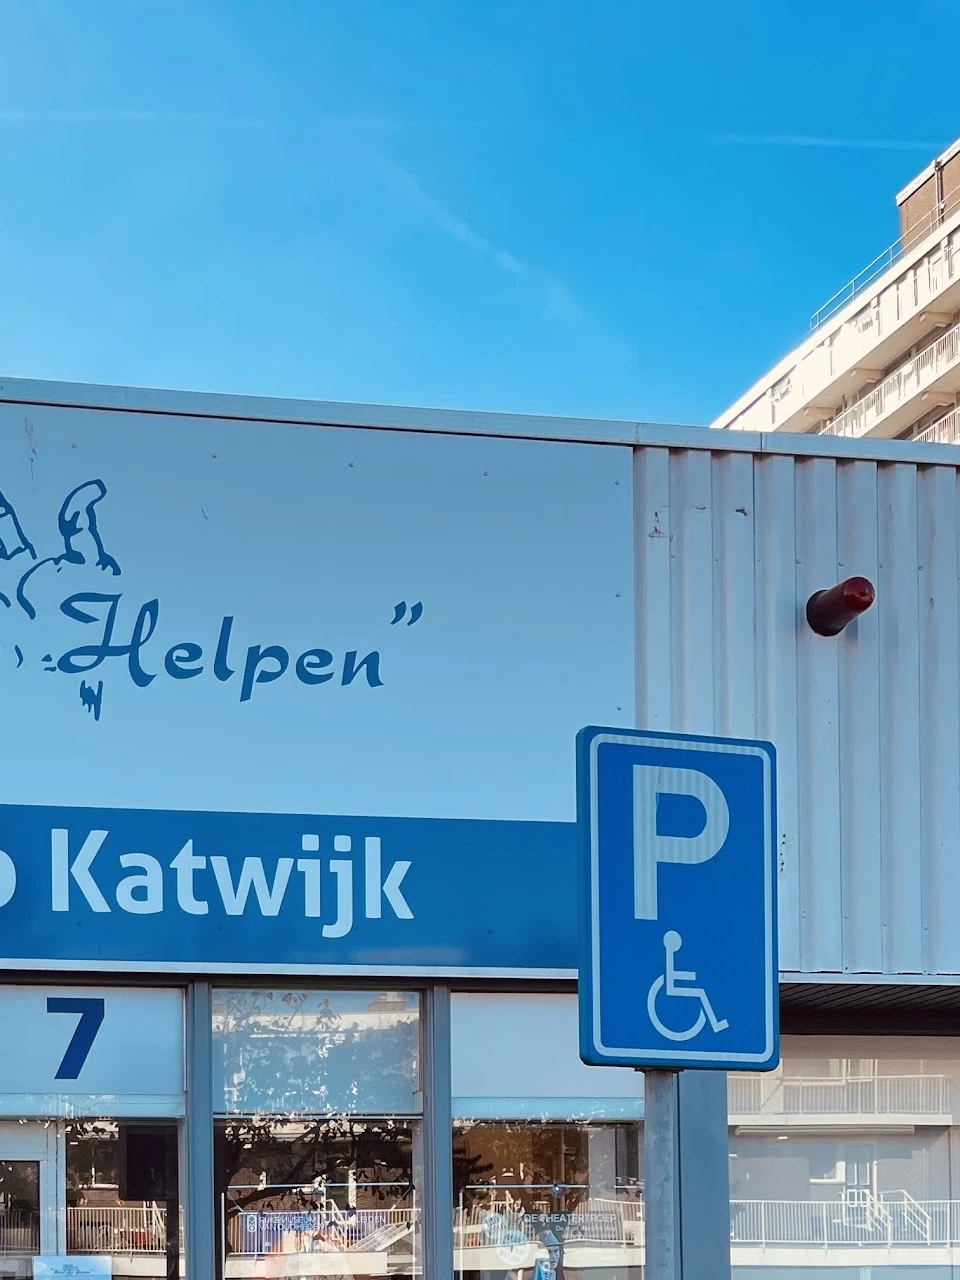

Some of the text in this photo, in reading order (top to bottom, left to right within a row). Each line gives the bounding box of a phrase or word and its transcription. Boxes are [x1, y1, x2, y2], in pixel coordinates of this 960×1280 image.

[57, 592, 384, 702] Helpen
[52, 829, 415, 938] Katwijk
[633, 765, 729, 920] P
[47, 997, 104, 1079] 7
